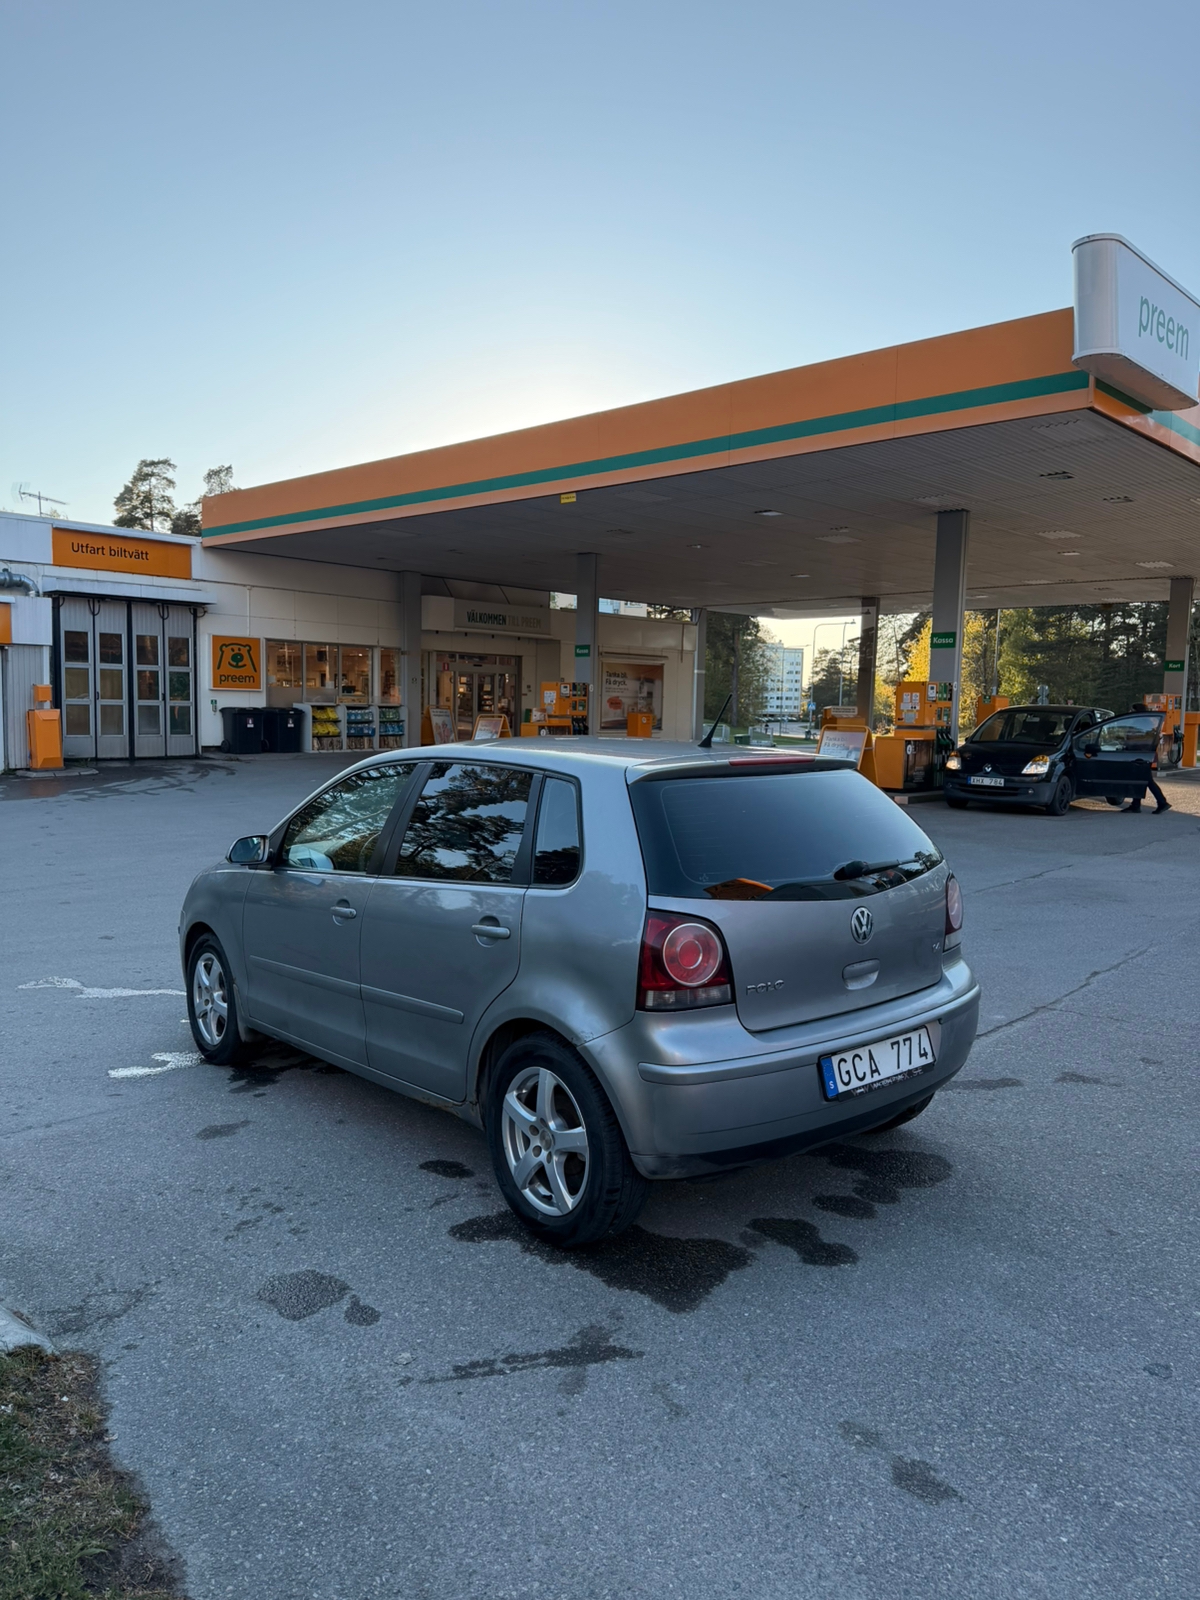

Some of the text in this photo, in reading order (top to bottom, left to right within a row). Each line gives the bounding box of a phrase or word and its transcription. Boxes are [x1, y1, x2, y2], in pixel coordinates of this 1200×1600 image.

[1138, 295, 1189, 361] preem
[71, 541, 149, 561] Utfart biltvätt
[466, 609, 541, 629] VÄLKOMMEN TILL PREEM
[932, 636, 954, 644] Kassa
[219, 673, 255, 685] preem
[745, 979, 785, 996] POLO
[837, 1048, 881, 1087] GCA
[890, 1033, 929, 1070] 774
[829, 1080, 835, 1089] S
